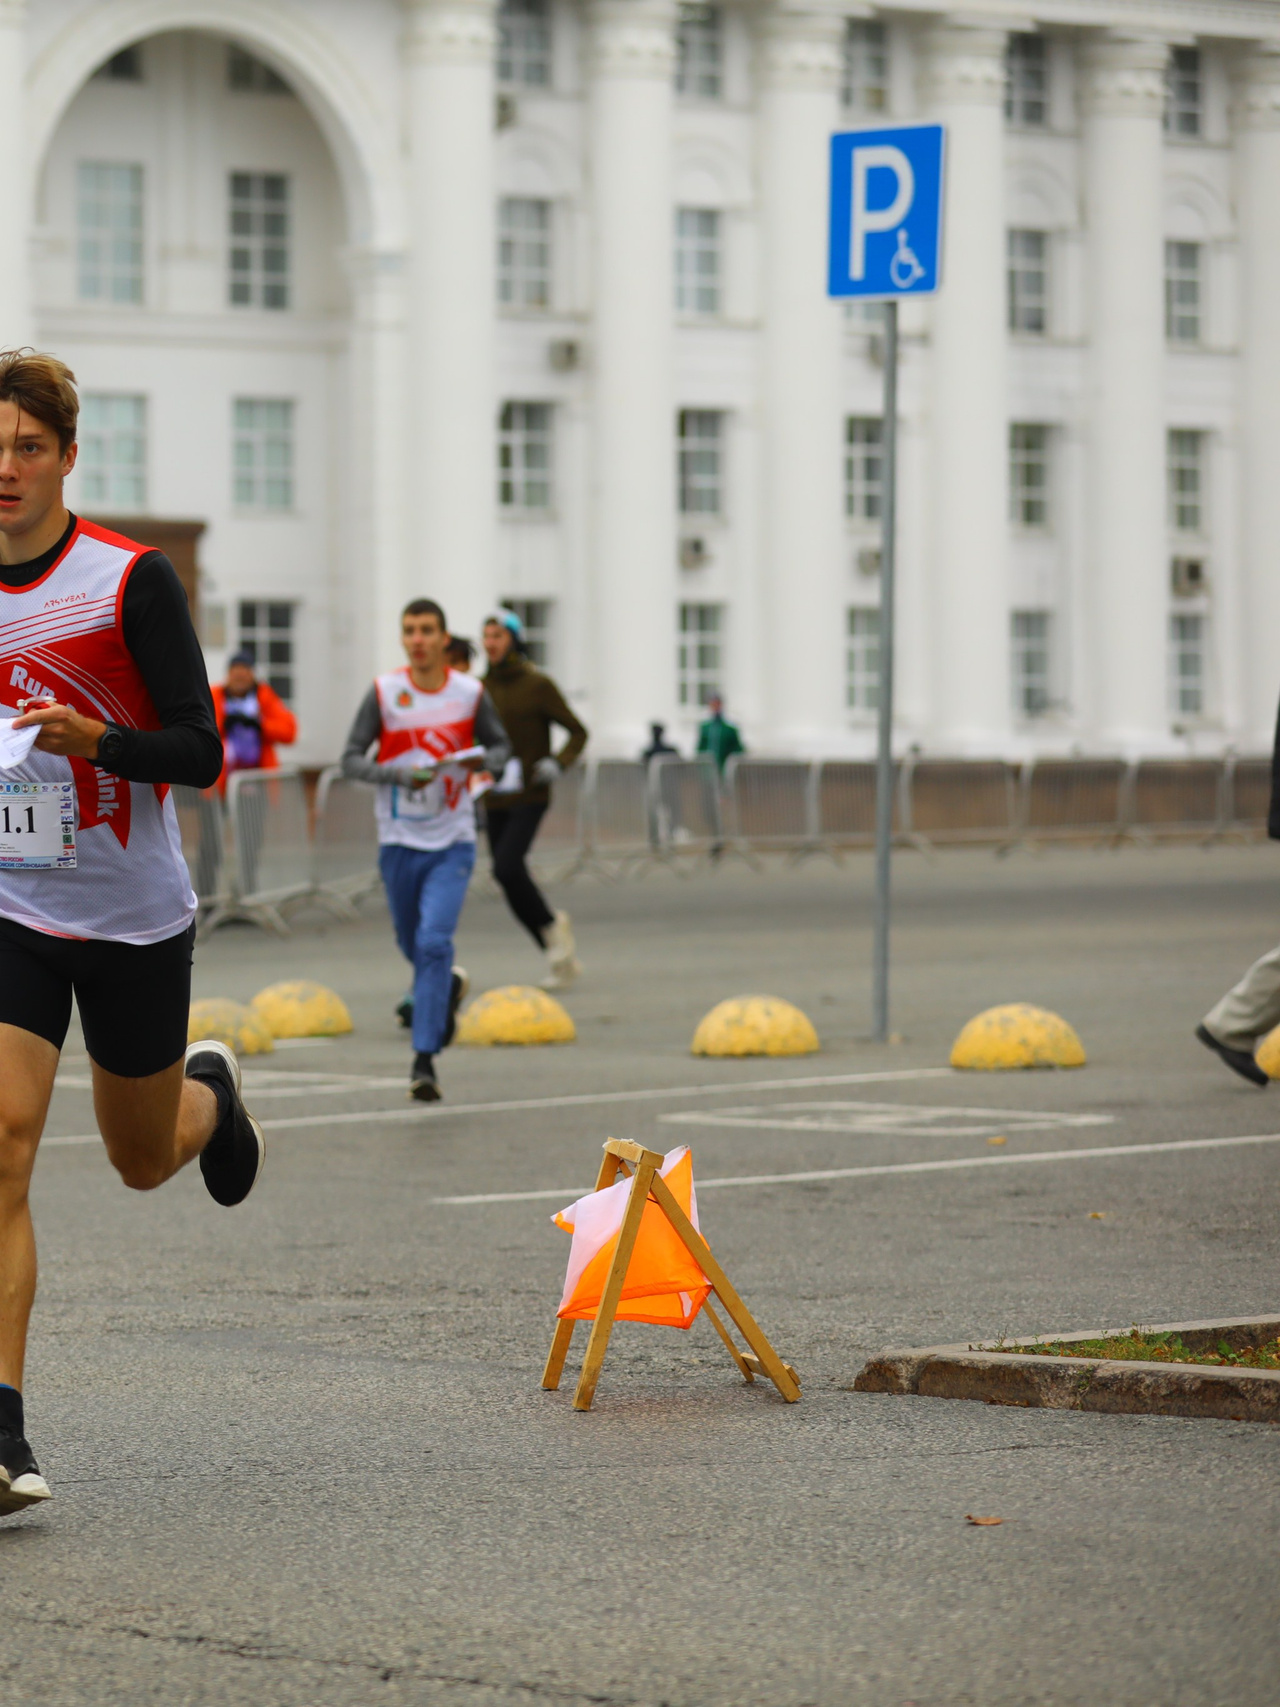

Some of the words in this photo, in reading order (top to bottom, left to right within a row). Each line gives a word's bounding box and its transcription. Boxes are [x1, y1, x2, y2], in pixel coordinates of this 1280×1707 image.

[849, 144, 915, 281] P
[9, 664, 55, 698] Run
[2, 805, 37, 833] 1.1
